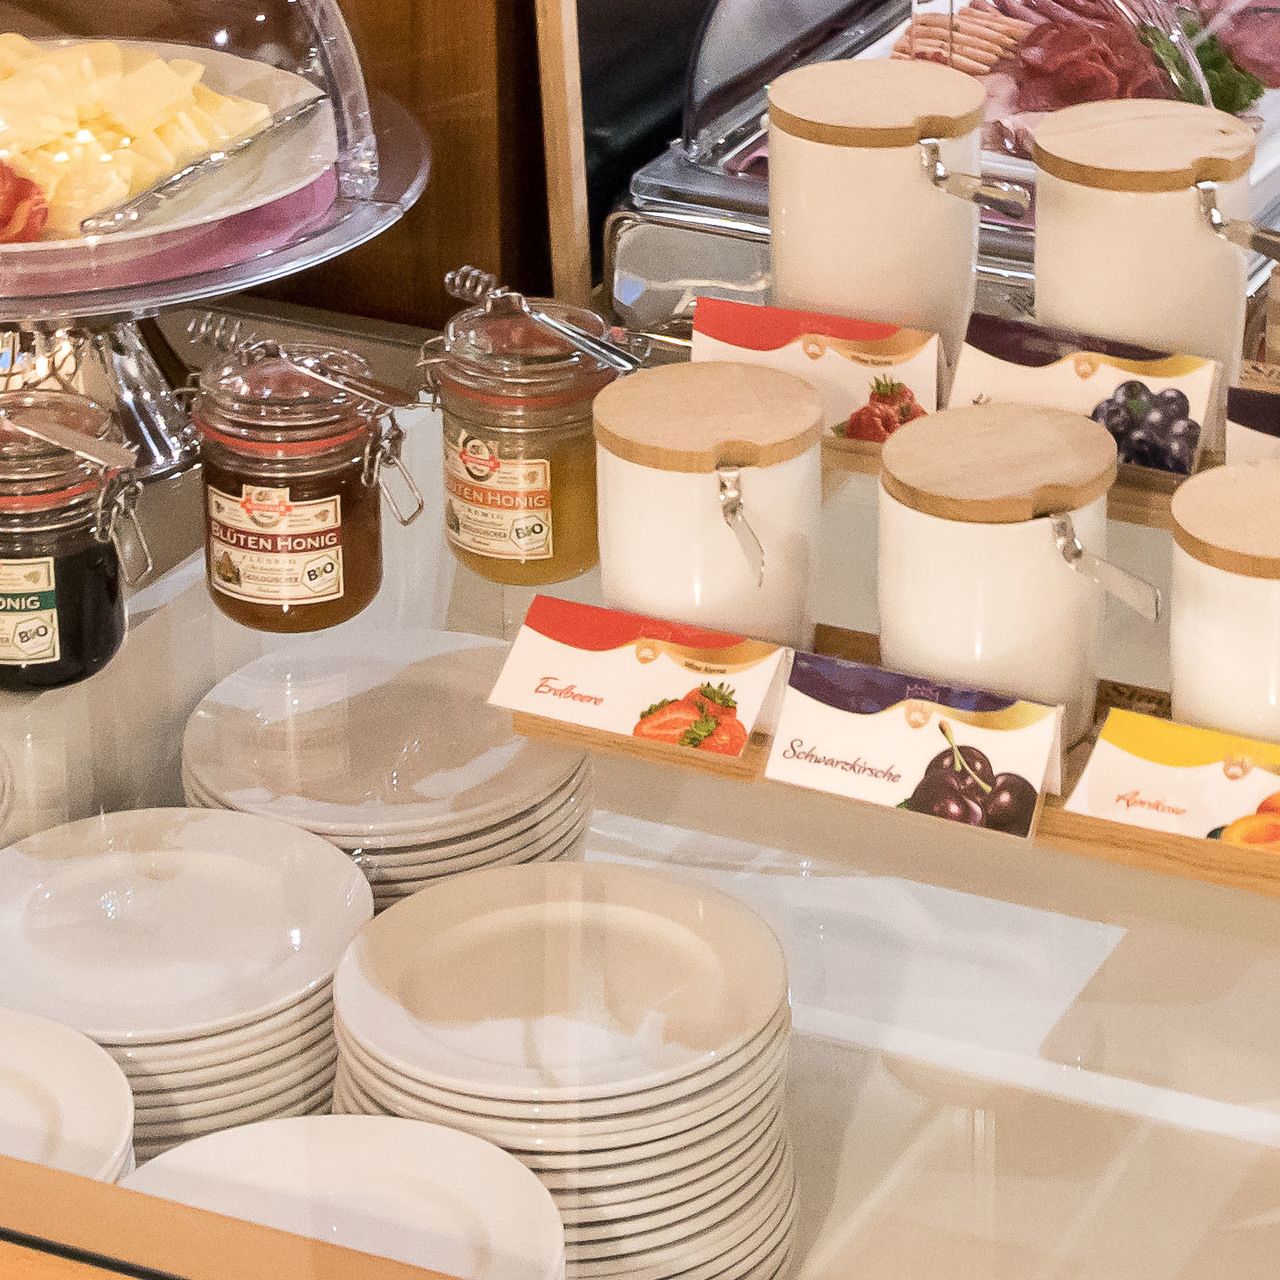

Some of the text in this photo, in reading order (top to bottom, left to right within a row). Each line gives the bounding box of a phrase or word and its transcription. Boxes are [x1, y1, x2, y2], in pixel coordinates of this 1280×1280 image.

[211, 520, 272, 551] BLÜTEN
[534, 676, 604, 706] Erdbeere
[782, 738, 902, 784] Schwarzkirsche
